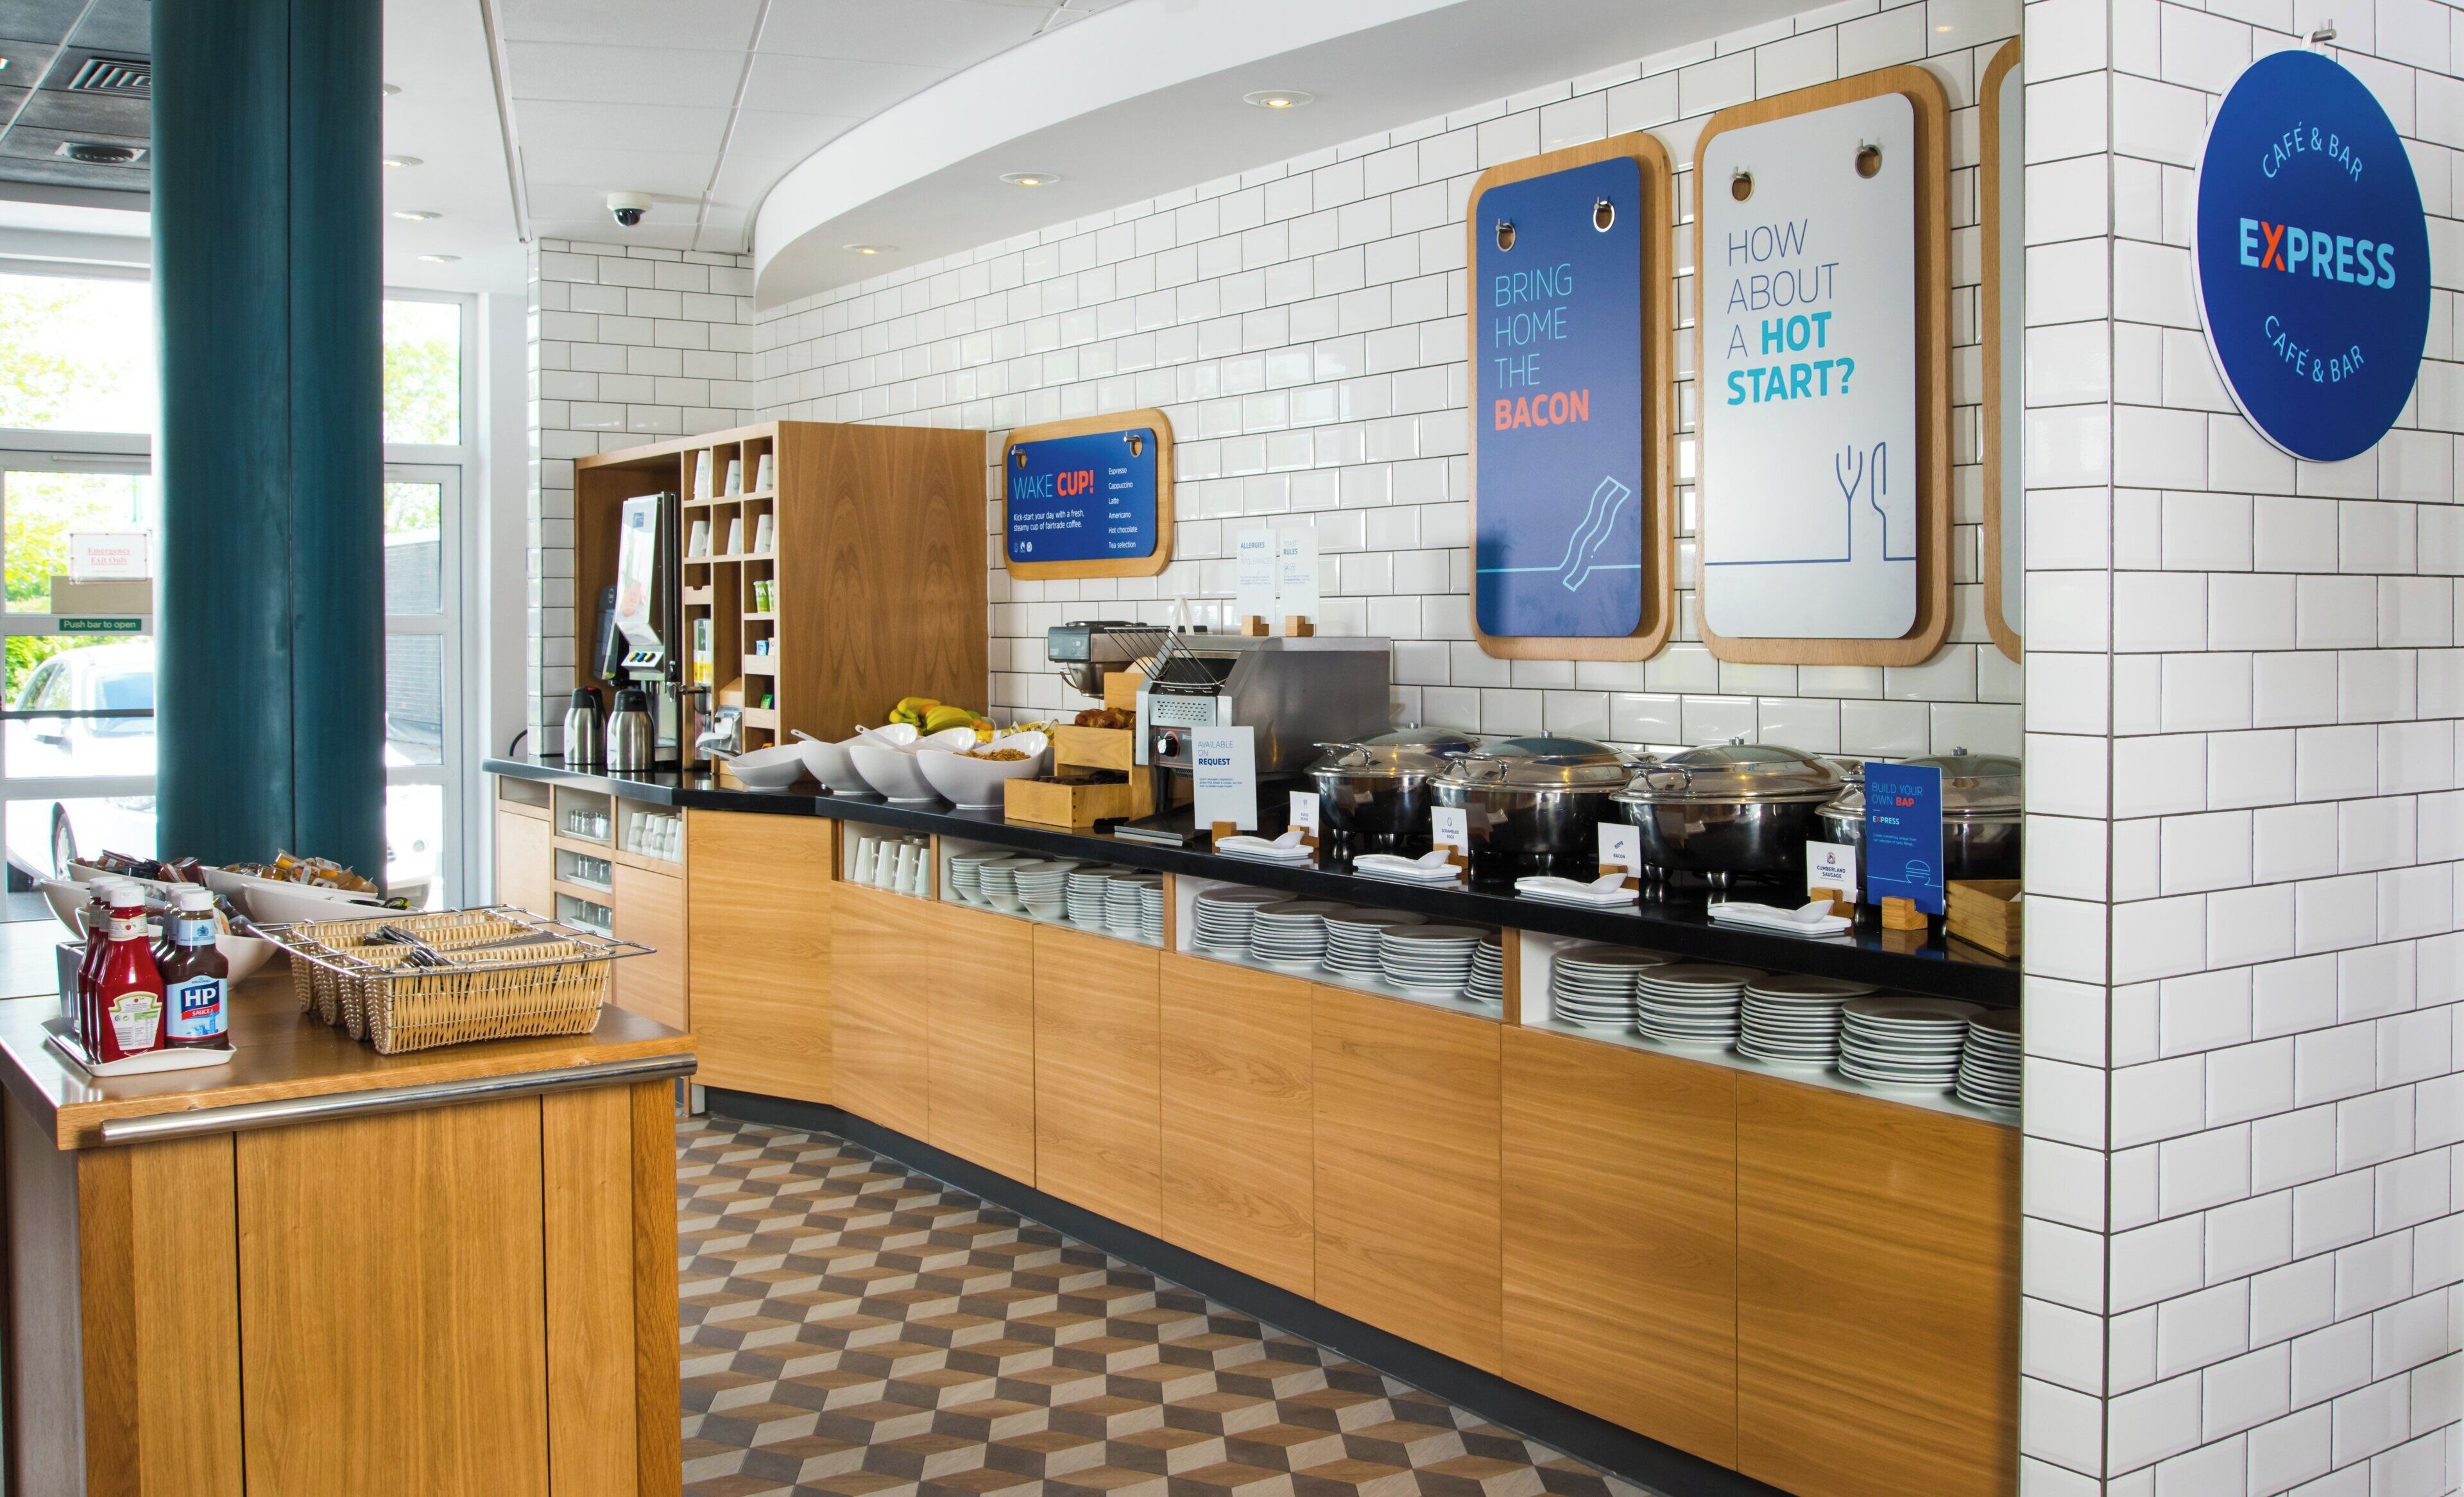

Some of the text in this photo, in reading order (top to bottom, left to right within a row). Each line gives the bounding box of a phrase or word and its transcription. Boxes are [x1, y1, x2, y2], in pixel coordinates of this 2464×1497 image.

[2263, 121, 2363, 182] CAFÉ & BAR
[1729, 218, 1808, 266] HOW
[2240, 217, 2396, 289] EXPRESS
[1496, 263, 1572, 307] BRING
[1727, 262, 1839, 314] ABOUT
[1496, 306, 1567, 348] HOME
[1727, 311, 1832, 359] A HOT
[2265, 315, 2365, 383] CAFÉ & BAR
[1494, 353, 1540, 389] THE
[1727, 357, 1855, 406] START?
[1495, 389, 1589, 431] BACON
[1013, 469, 1094, 500] WAKE CUP!
[1108, 467, 1127, 475] Espresso
[1040, 522, 1045, 530] of
[1045, 521, 1065, 529] fairtrade
[1066, 520, 1082, 528] coffee.
[1056, 510, 1066, 518] with
[1071, 509, 1084, 517] fresh,
[114, 621, 136, 629] open
[1199, 758, 1231, 766] REQUEST
[1872, 782, 1923, 796] BUILD YOUR
[1872, 794, 1915, 807] OWN BAP
[1872, 816, 1899, 825] EXPRESS
[1817, 865, 1846, 873] CUMBERLAND
[185, 988, 217, 1007] HP
